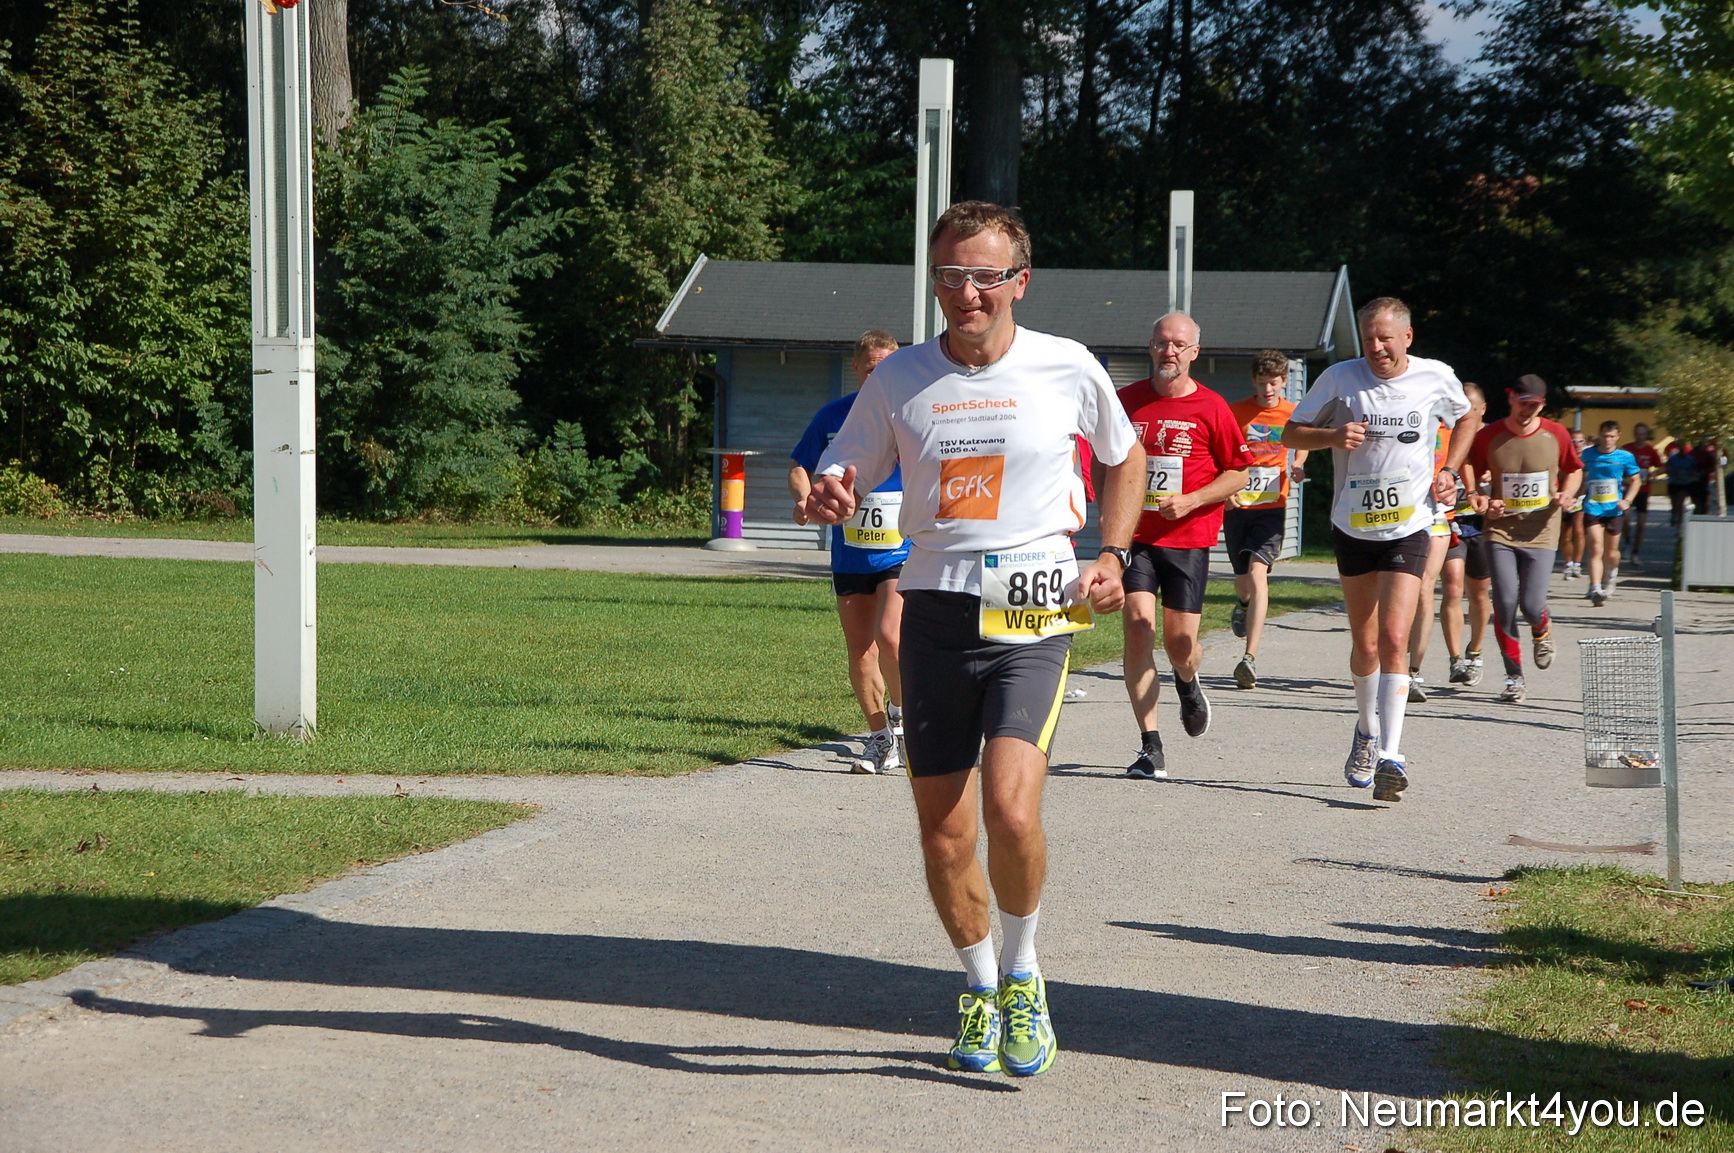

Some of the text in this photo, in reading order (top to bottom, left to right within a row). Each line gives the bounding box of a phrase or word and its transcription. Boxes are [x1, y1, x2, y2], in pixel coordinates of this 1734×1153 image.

[931, 398, 1018, 414] SportScheck
[931, 417, 967, 426] Nürnberger
[967, 414, 998, 422] Stadtlauf
[1361, 413, 1404, 427] Allianz
[960, 437, 1006, 445] Katzwang
[940, 447, 962, 455] 1905
[946, 473, 995, 501] GfK
[1511, 483, 1539, 498] 329
[1361, 486, 1399, 511] 496
[1365, 511, 1400, 524] Georg
[856, 529, 886, 541] Peter
[1000, 551, 1047, 562] PFLEIDERER
[1007, 568, 1065, 607] 869
